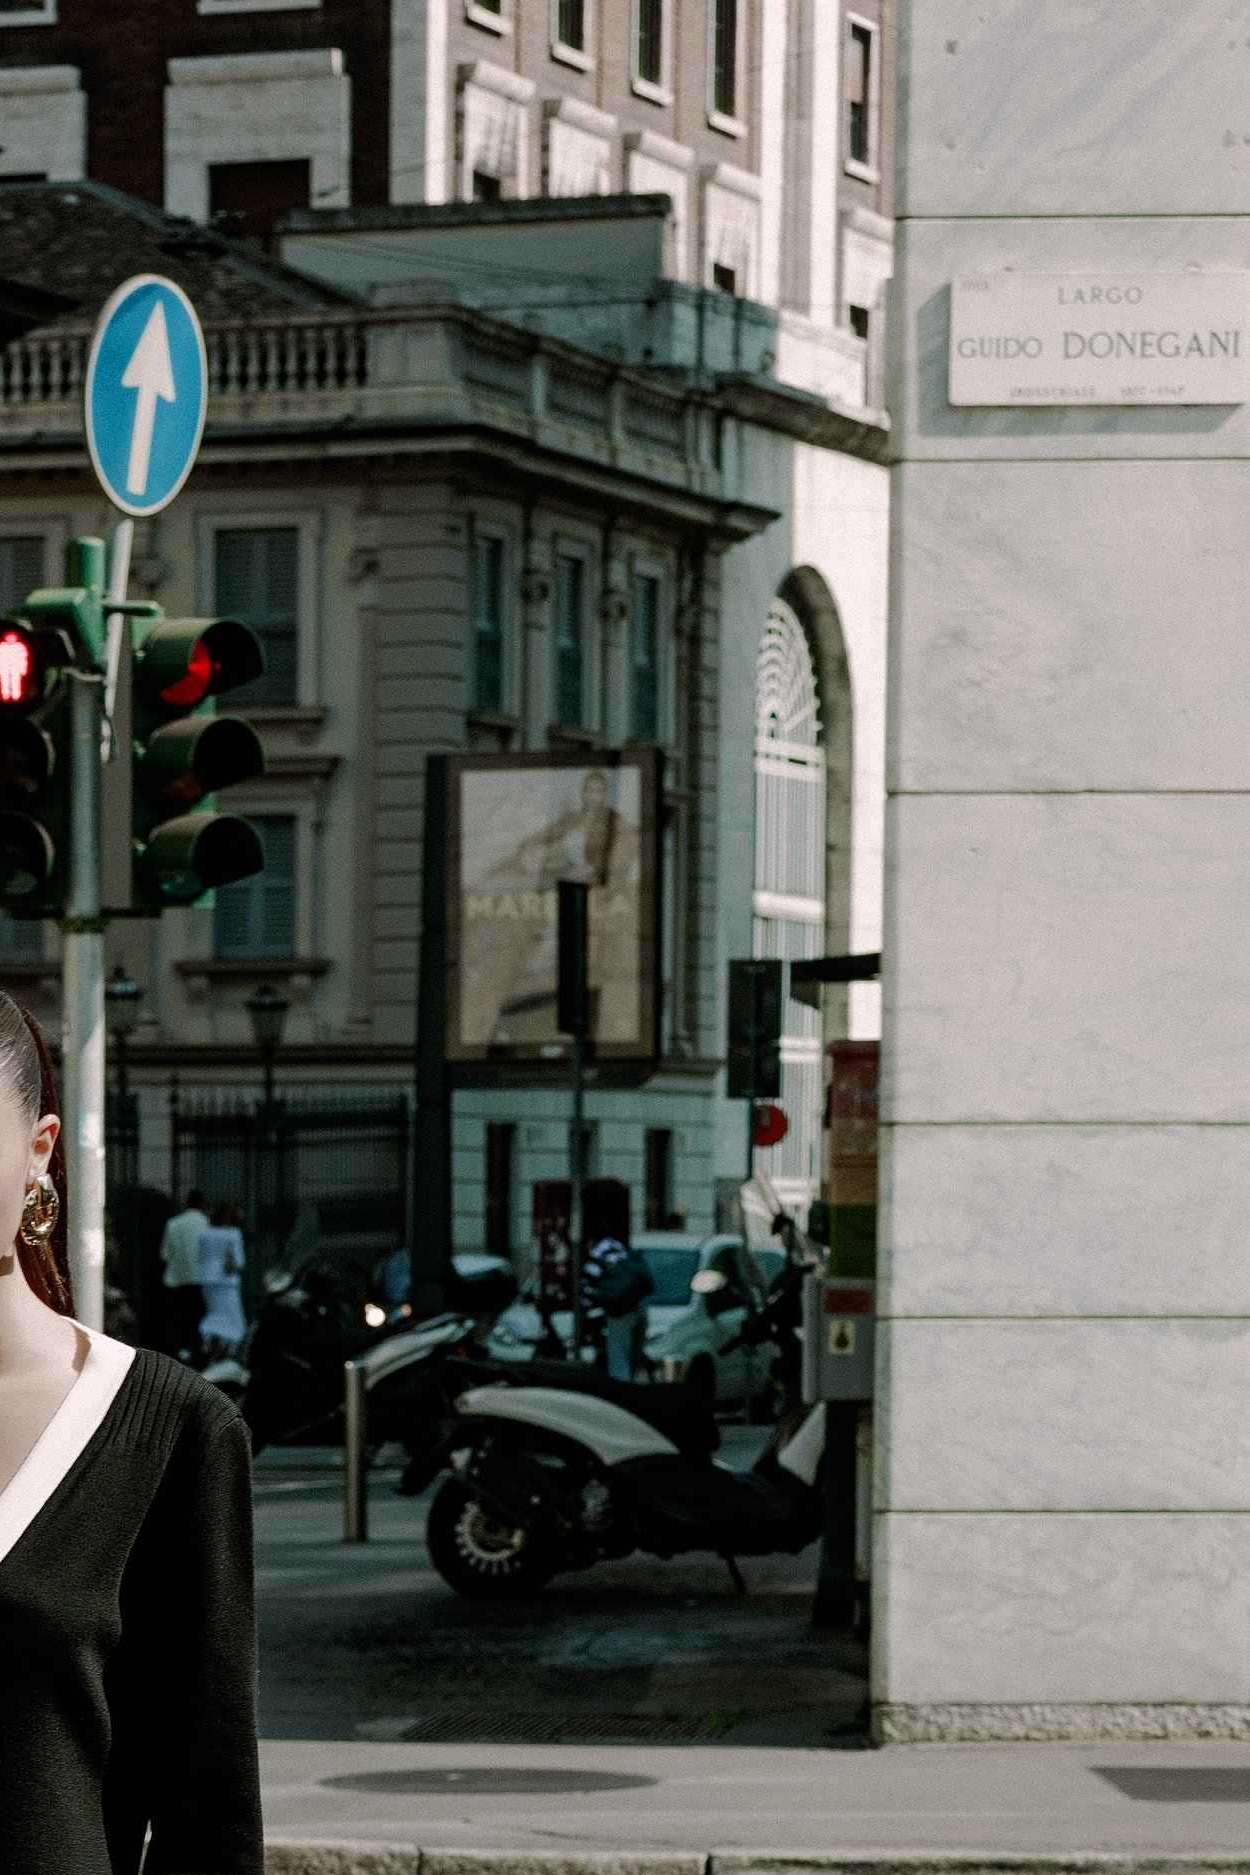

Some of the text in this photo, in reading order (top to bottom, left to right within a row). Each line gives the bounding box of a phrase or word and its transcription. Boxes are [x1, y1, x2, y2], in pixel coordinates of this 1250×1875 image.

[1057, 286, 1143, 305] LARGO
[956, 329, 1240, 359] GUIDO DONEGANI
